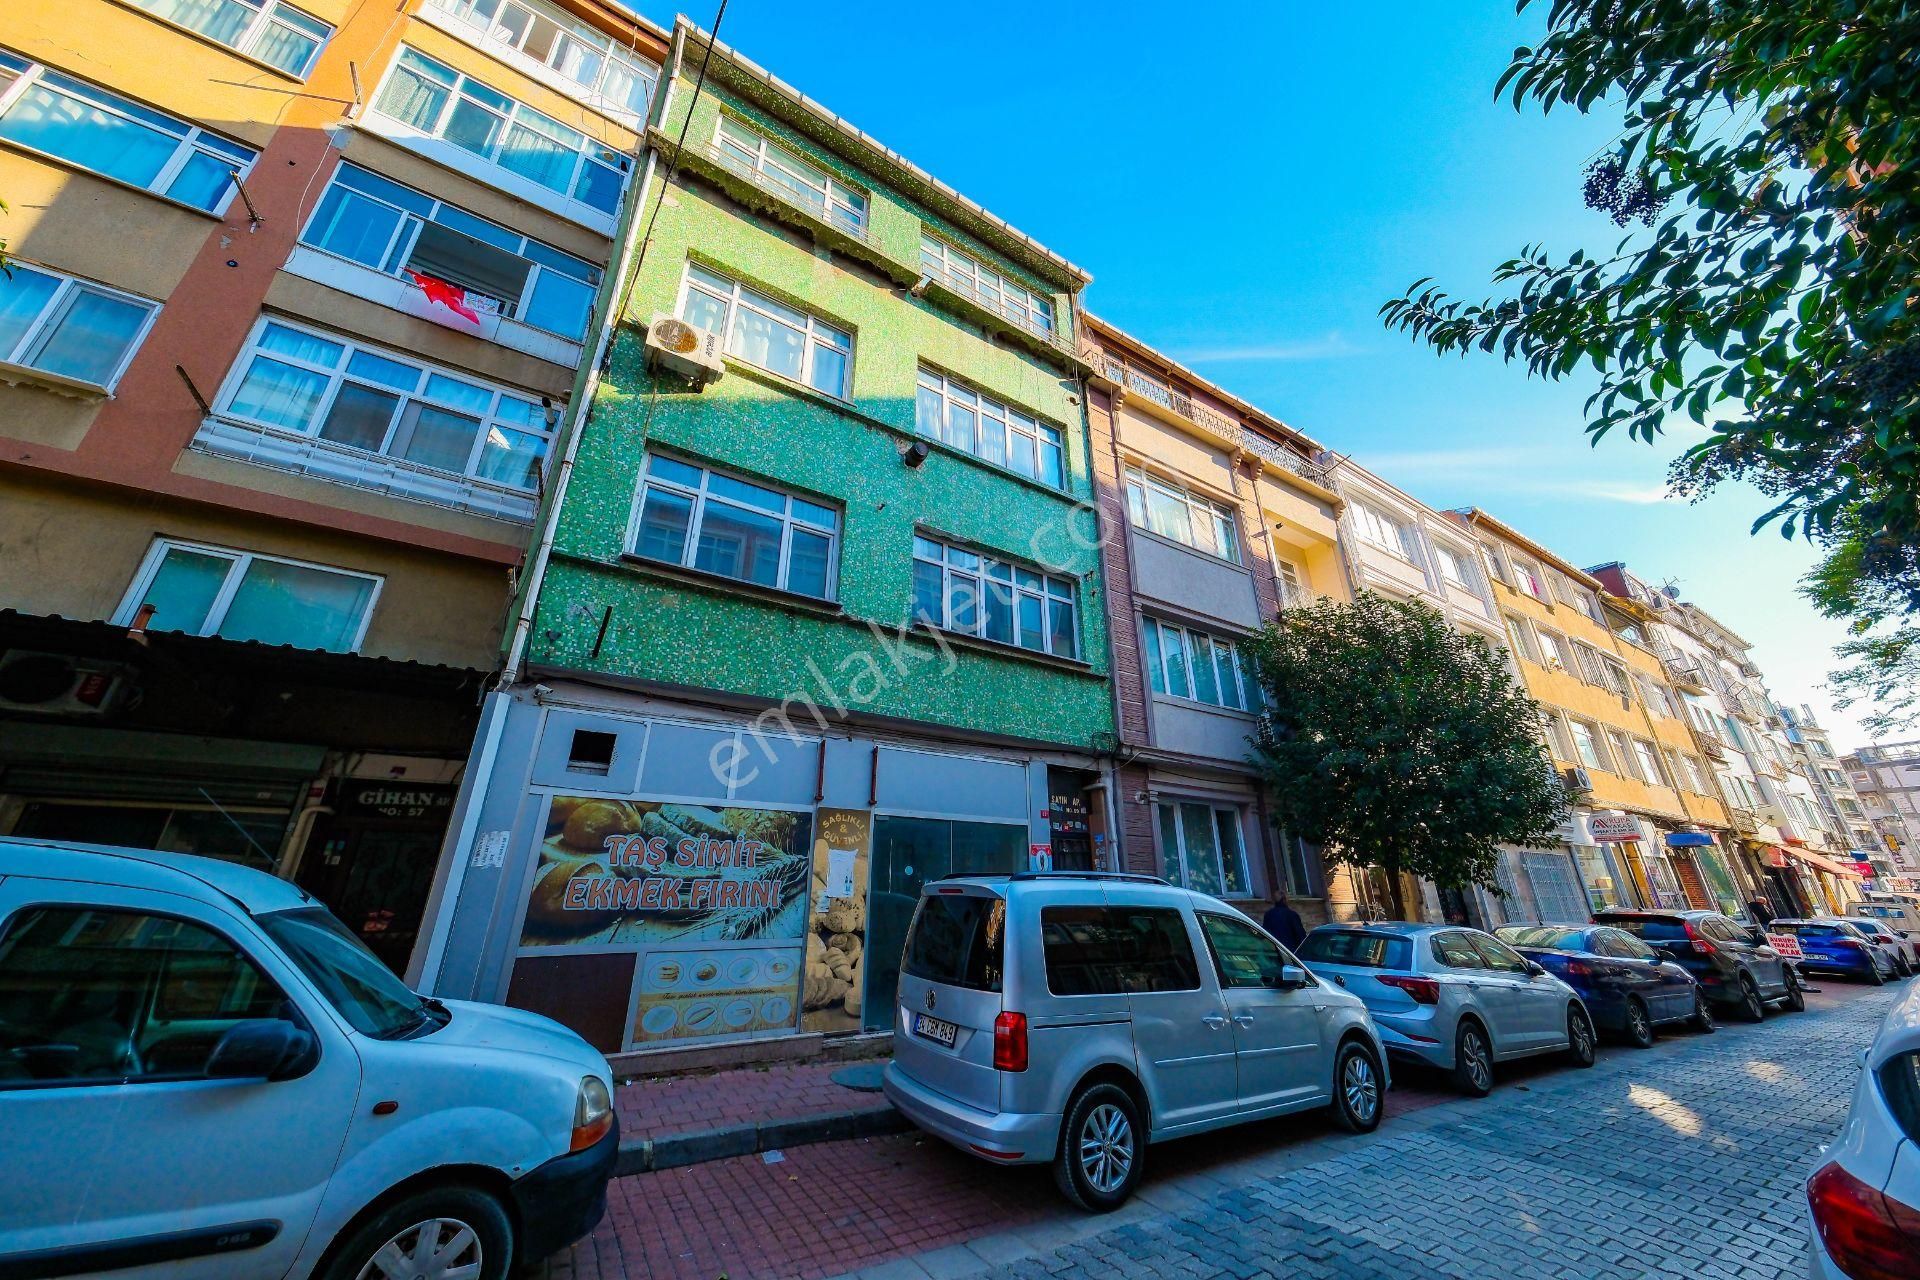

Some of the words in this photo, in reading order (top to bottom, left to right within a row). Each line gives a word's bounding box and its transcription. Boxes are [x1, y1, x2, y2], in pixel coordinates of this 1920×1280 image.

[408, 807, 425, 816] 57
[822, 813, 865, 830] SAĞLIKLI
[839, 824, 847, 833] &
[603, 834, 667, 873] TAŞ
[674, 832, 764, 869] SİMİT
[562, 877, 681, 911] EKMEK
[689, 878, 784, 911] FIRINI
